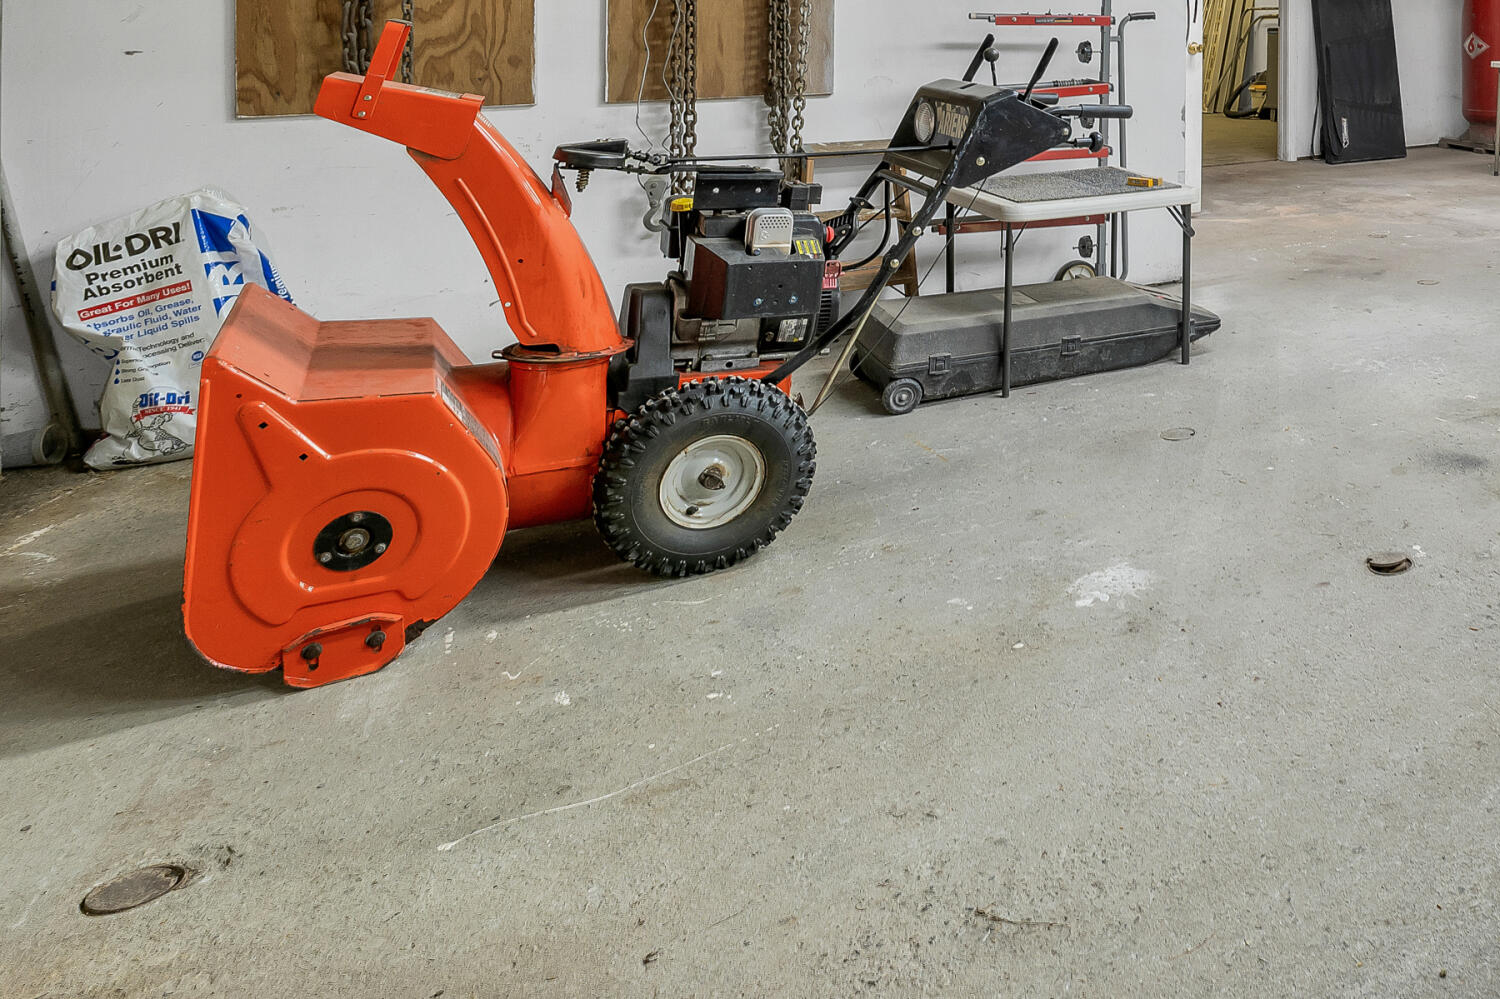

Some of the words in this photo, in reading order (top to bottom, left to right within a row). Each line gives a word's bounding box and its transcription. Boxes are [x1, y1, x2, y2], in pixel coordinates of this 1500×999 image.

[83, 262, 183, 302] Absorbent
[85, 253, 174, 287] Premium
[79, 304, 113, 320] Great
[114, 299, 136, 311] For
[136, 291, 161, 305] Many
[162, 282, 191, 297] Uses!
[172, 303, 202, 318] Water
[86, 313, 136, 331] bsorbs
[155, 298, 194, 313] Grease,
[137, 323, 169, 338] Liquid
[171, 314, 201, 330] Spills
[181, 331, 195, 342] and
[142, 342, 178, 359] ocessing
[139, 390, 191, 408] Oil-Dri
